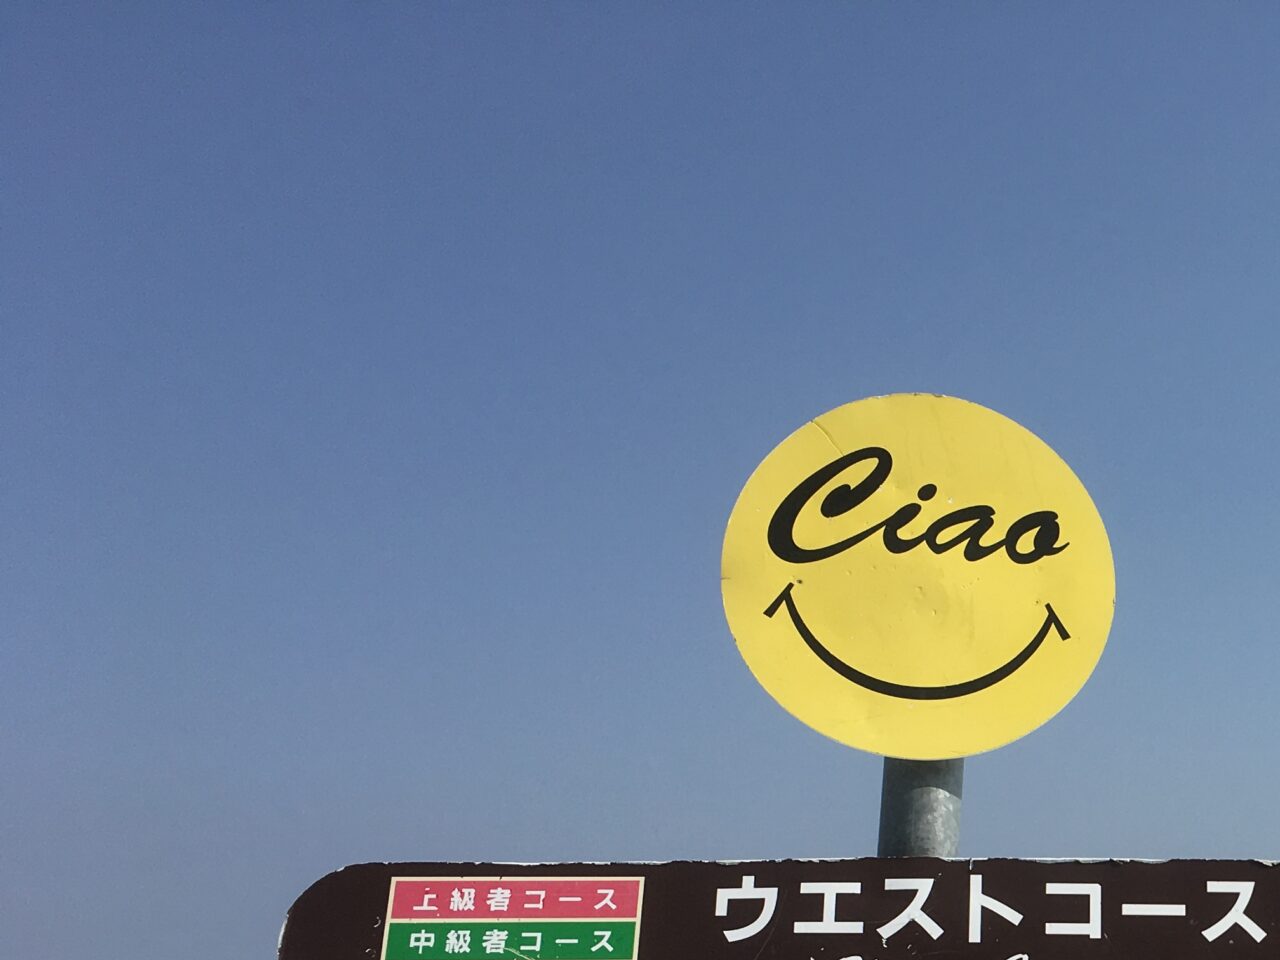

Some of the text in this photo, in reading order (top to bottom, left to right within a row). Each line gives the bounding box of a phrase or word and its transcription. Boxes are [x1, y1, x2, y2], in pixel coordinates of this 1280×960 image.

[768, 446, 1070, 565] Ciao
[413, 887, 617, 912] 上級者コース
[714, 874, 1268, 944] ウエストコース
[409, 929, 614, 954] 中級者コース
